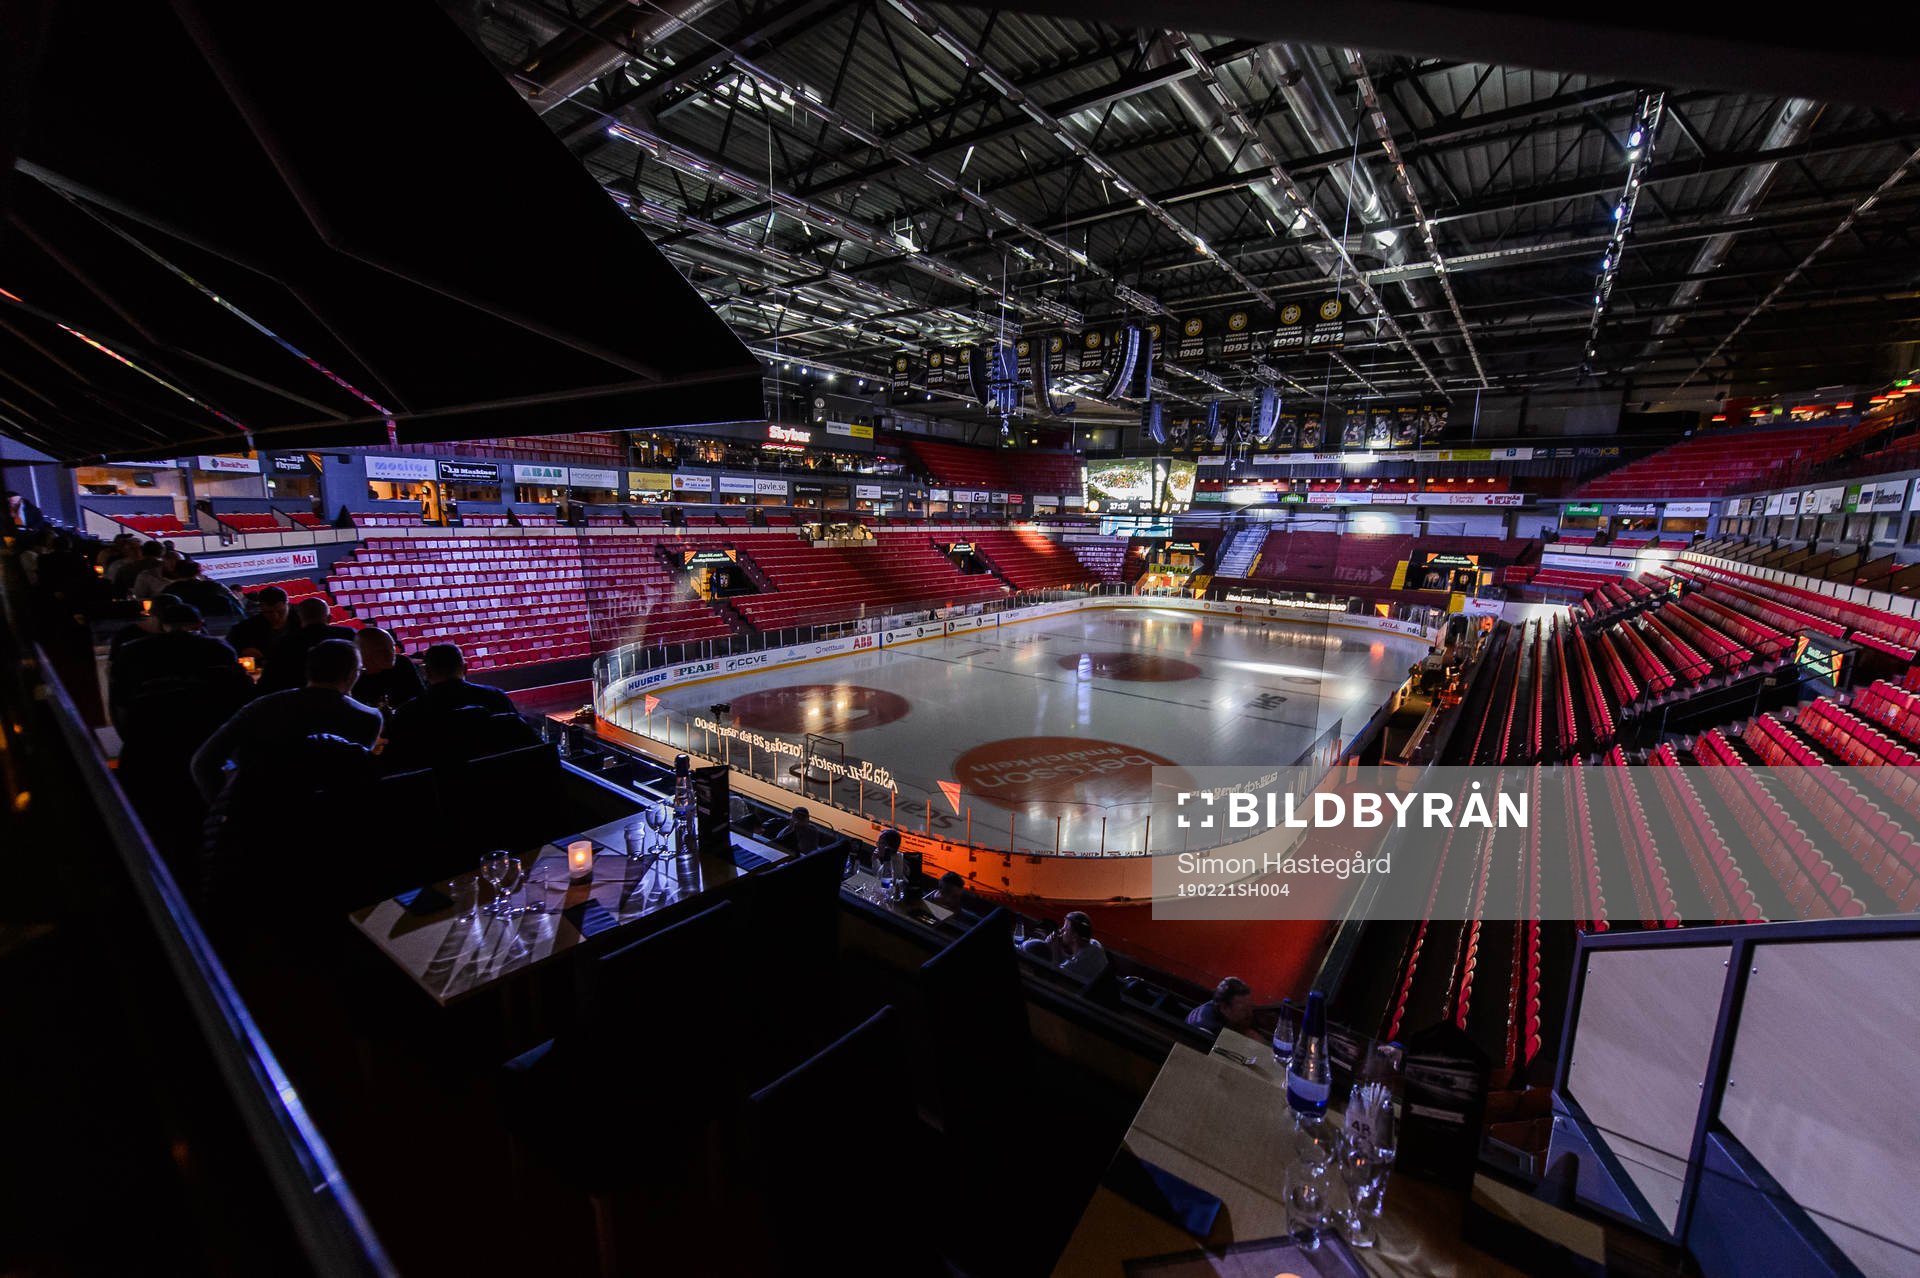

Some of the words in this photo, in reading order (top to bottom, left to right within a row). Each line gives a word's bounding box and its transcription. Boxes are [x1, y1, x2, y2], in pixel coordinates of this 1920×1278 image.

[1274, 337, 1303, 347] 1999
[1311, 332, 1344, 344] 2012
[1180, 348, 1205, 358] 1980
[1082, 360, 1102, 368] 1972
[769, 425, 810, 442] Skybar
[521, 468, 562, 479] ABAB
[854, 636, 873, 651] ABB
[738, 654, 768, 666] CCVE
[678, 661, 714, 677] PEAB
[627, 672, 667, 691] HUURRE
[974, 754, 1159, 788] betsson
